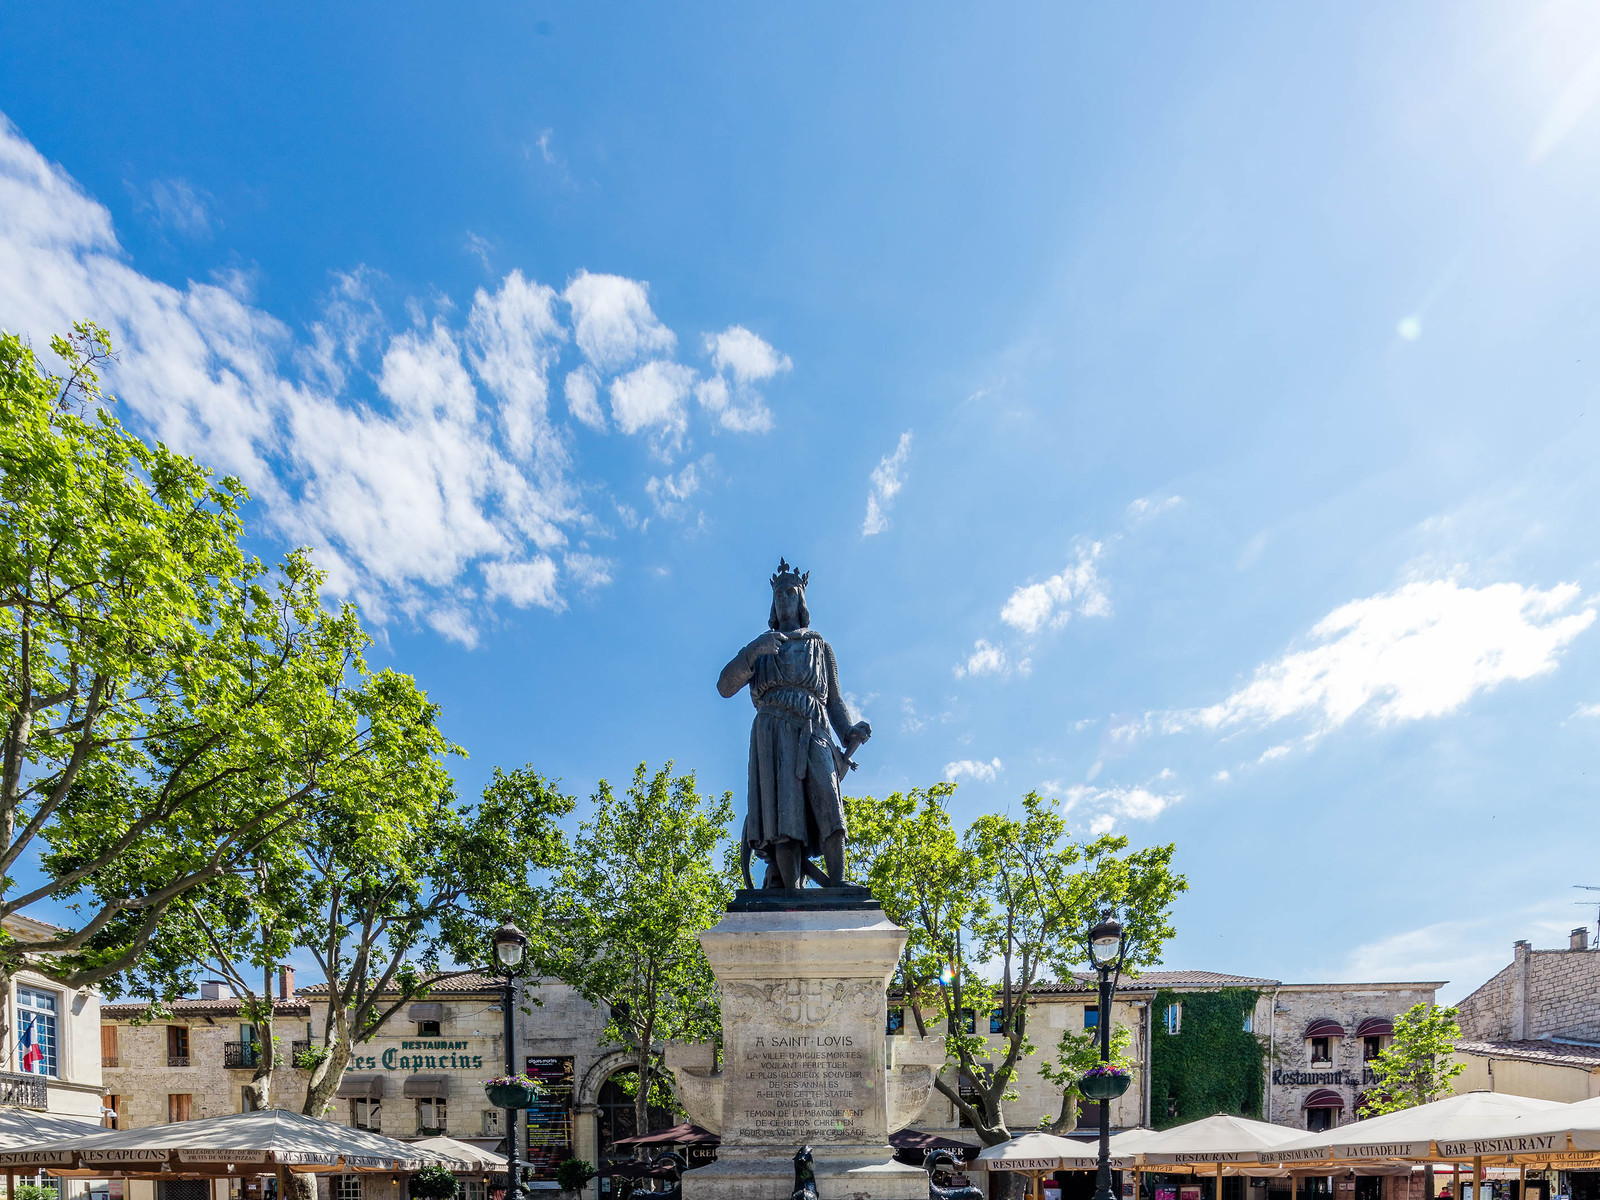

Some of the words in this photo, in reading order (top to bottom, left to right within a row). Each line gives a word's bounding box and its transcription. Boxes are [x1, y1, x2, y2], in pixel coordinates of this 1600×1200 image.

[401, 1041, 469, 1050] RESTAURANT
[771, 1036, 809, 1047] SAINT
[817, 1035, 853, 1047] LOVIS
[382, 1047, 483, 1073] Capucins
[746, 1052, 759, 1060] LA
[762, 1052, 786, 1060] VILLE
[823, 1071, 863, 1079] SOUVENIR
[1272, 1069, 1343, 1086] Restaurant
[768, 1081, 780, 1089] DE
[783, 1081, 799, 1089] SES
[801, 1081, 839, 1089] ANNALES
[793, 1090, 821, 1098] CETTE
[824, 1090, 853, 1098] STATUE
[778, 1109, 789, 1117] DE
[755, 1119, 765, 1127] DE
[769, 1119, 780, 1127] CE
[83, 1151, 103, 1161] LES
[107, 1150, 167, 1160] CAPUCINS
[1346, 1147, 1359, 1157] LA
[1359, 1145, 1412, 1156] CITADELLE
[282, 1152, 333, 1164] RESTAURANT
[1174, 1153, 1241, 1162] RESTAURANT
[993, 1158, 1056, 1169] RESTAURANT
[1074, 1158, 1086, 1167] LE
[1089, 1158, 1123, 1167] MOS
